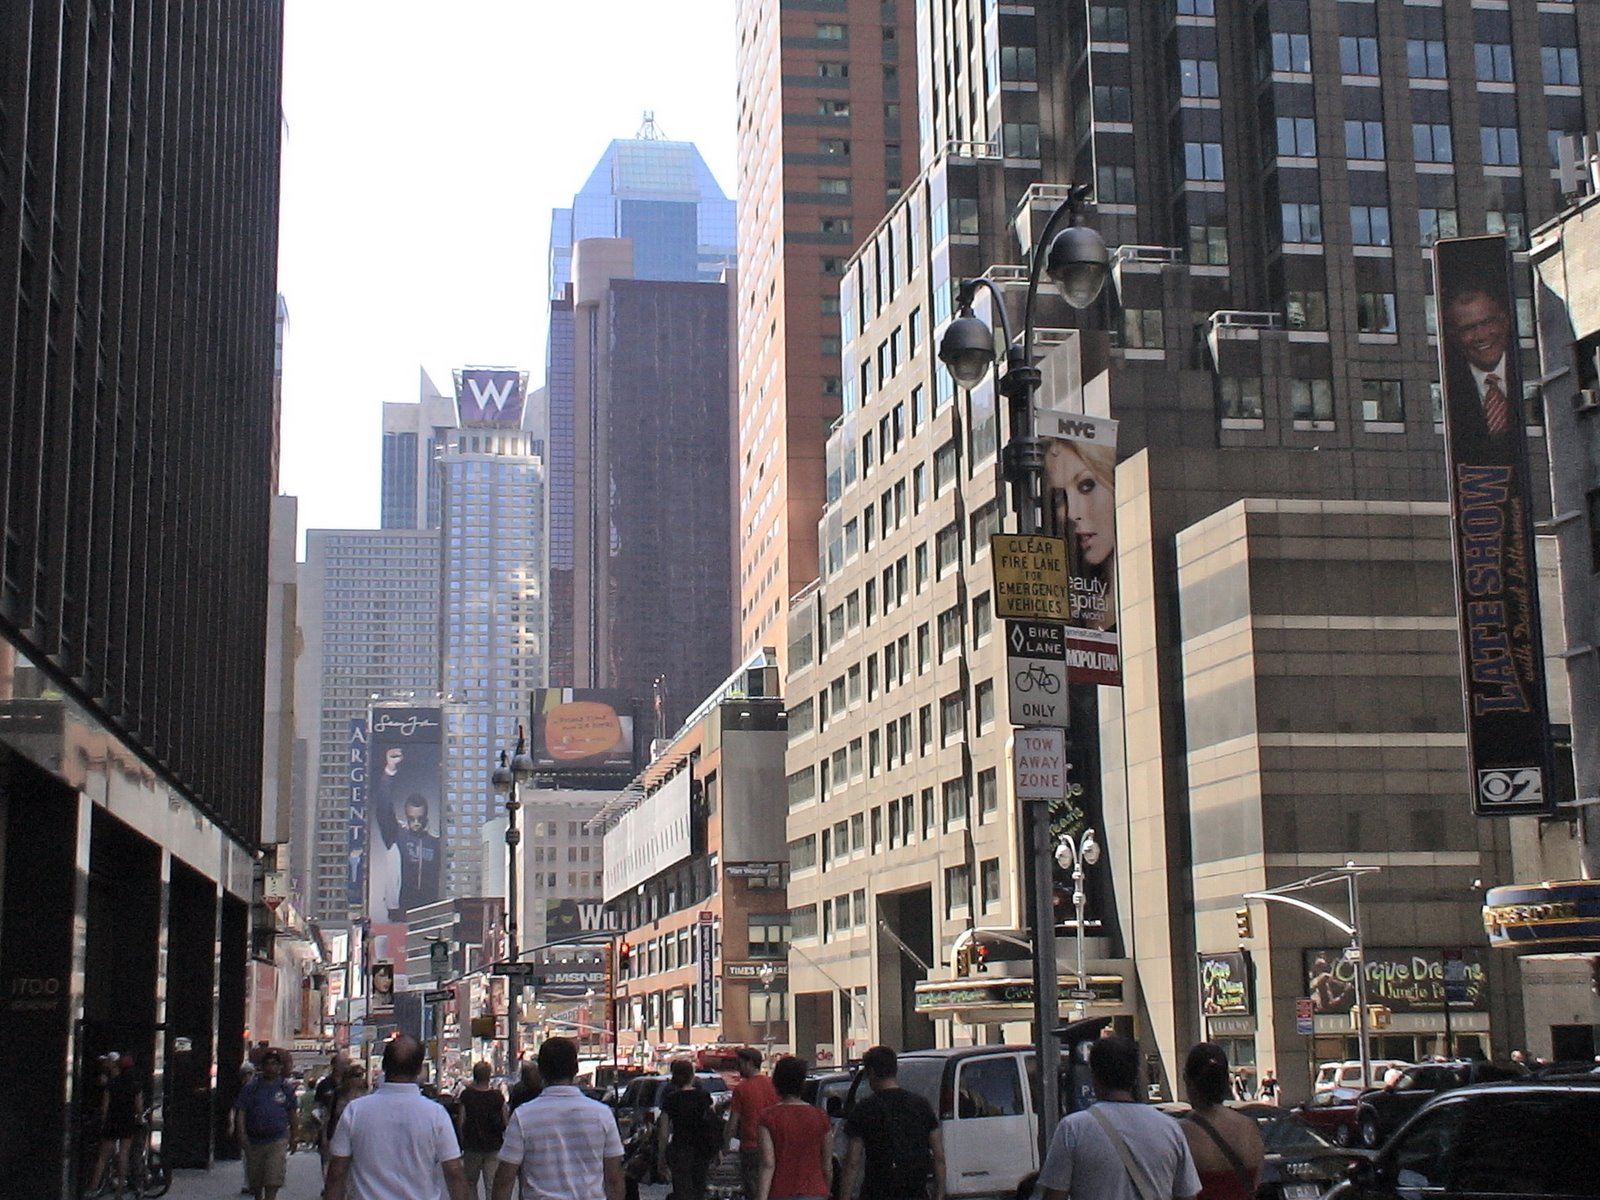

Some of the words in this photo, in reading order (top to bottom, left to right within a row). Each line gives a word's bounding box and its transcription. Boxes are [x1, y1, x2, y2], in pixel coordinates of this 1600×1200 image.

[468, 379, 515, 412] W
[1058, 418, 1096, 439] NYC
[1457, 463, 1513, 596] SHOW
[1009, 540, 1053, 555] CLEAR
[1002, 556, 1028, 569] FIRE
[1034, 557, 1061, 571] LANE
[1025, 571, 1042, 581] FOR
[999, 581, 1067, 598] EMERGENCY
[1006, 599, 1061, 614] VEHICLES
[1028, 626, 1059, 640] BIKE
[1026, 642, 1063, 655] LANE
[1467, 601, 1531, 716] LATE
[1022, 703, 1056, 718] ONLY
[1024, 738, 1053, 750] TOW
[1019, 756, 1059, 769] AWAY
[1019, 774, 1060, 788] ZONE
[555, 972, 605, 983] MSNB
[729, 966, 755, 976] TIMES
[1335, 956, 1410, 998] Crque
[12, 978, 60, 994] 1700
